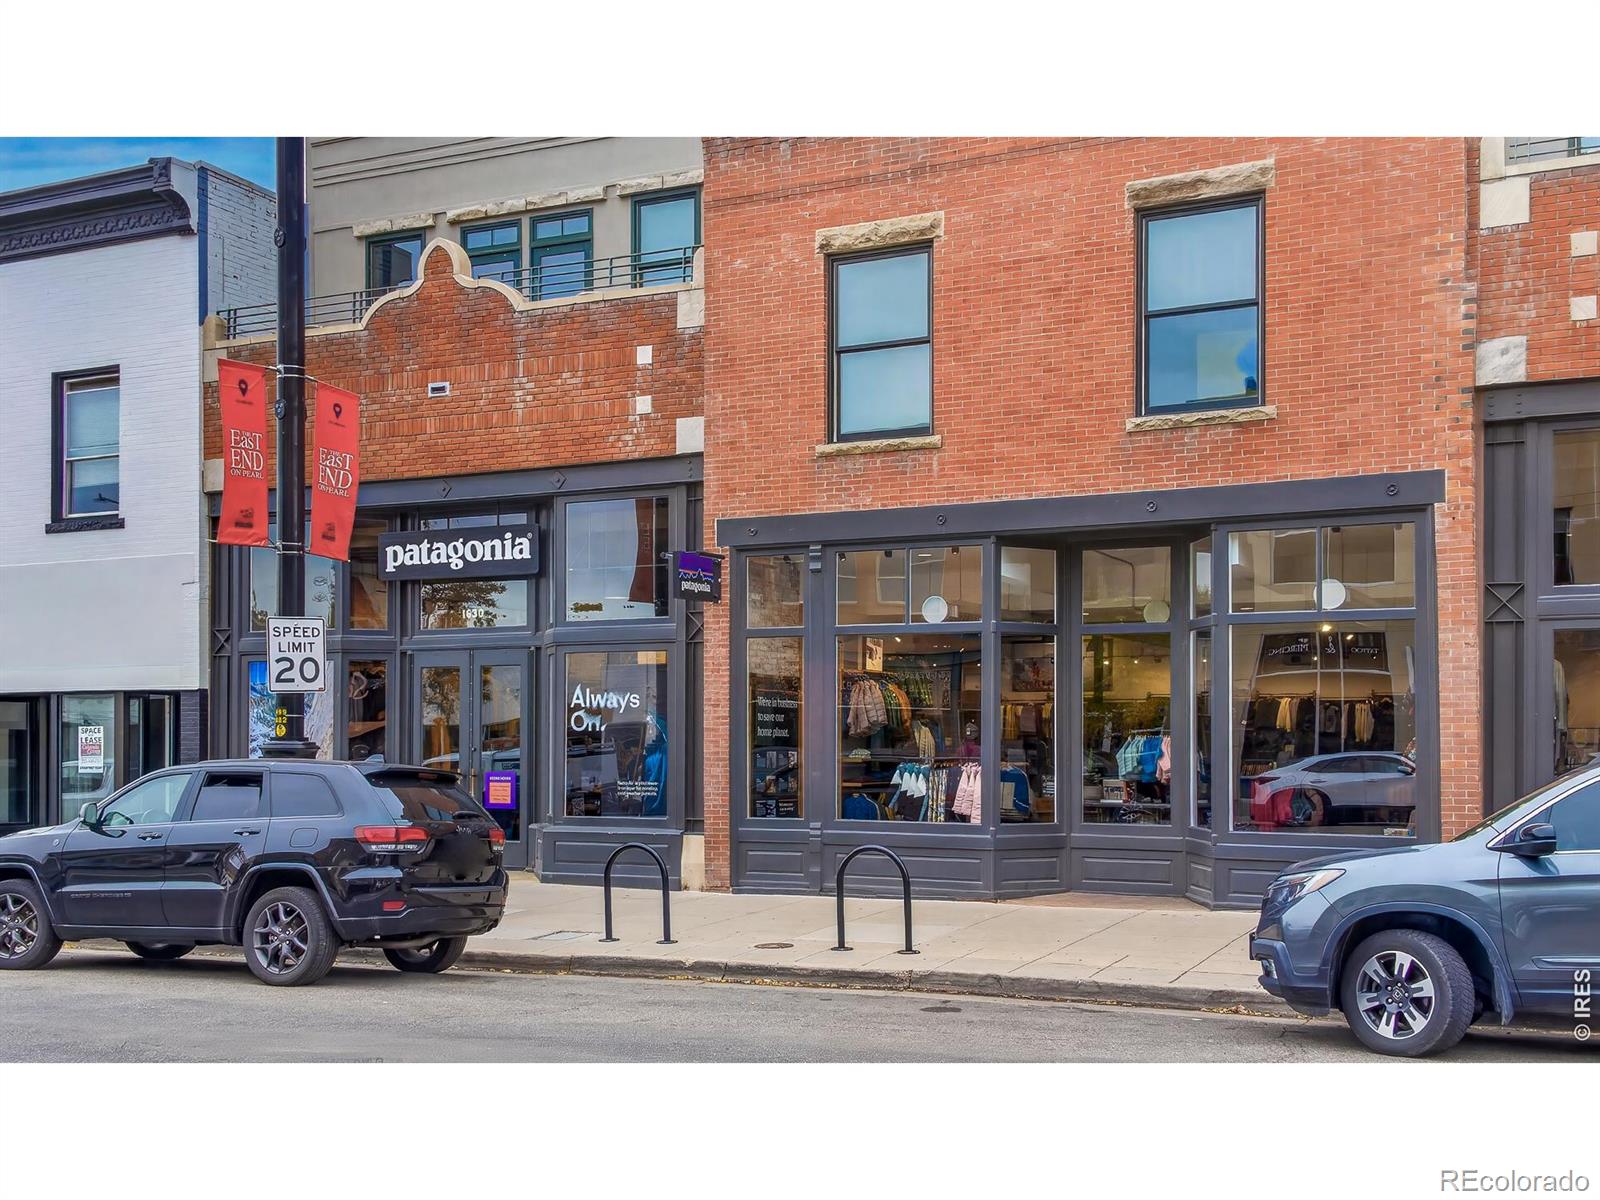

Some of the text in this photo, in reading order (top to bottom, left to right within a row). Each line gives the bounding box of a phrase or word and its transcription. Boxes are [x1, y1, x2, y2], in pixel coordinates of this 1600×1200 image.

[230, 448, 264, 471] END
[242, 471, 264, 480] PEARL
[318, 465, 352, 489] END
[681, 580, 711, 593] patagonia
[462, 608, 485, 619] 1630
[272, 626, 321, 638] SPEED
[278, 641, 316, 653] LIMIT
[274, 656, 320, 684] 20
[570, 683, 641, 713] Always
[757, 726, 772, 736] home
[80, 736, 102, 744] LEASE
